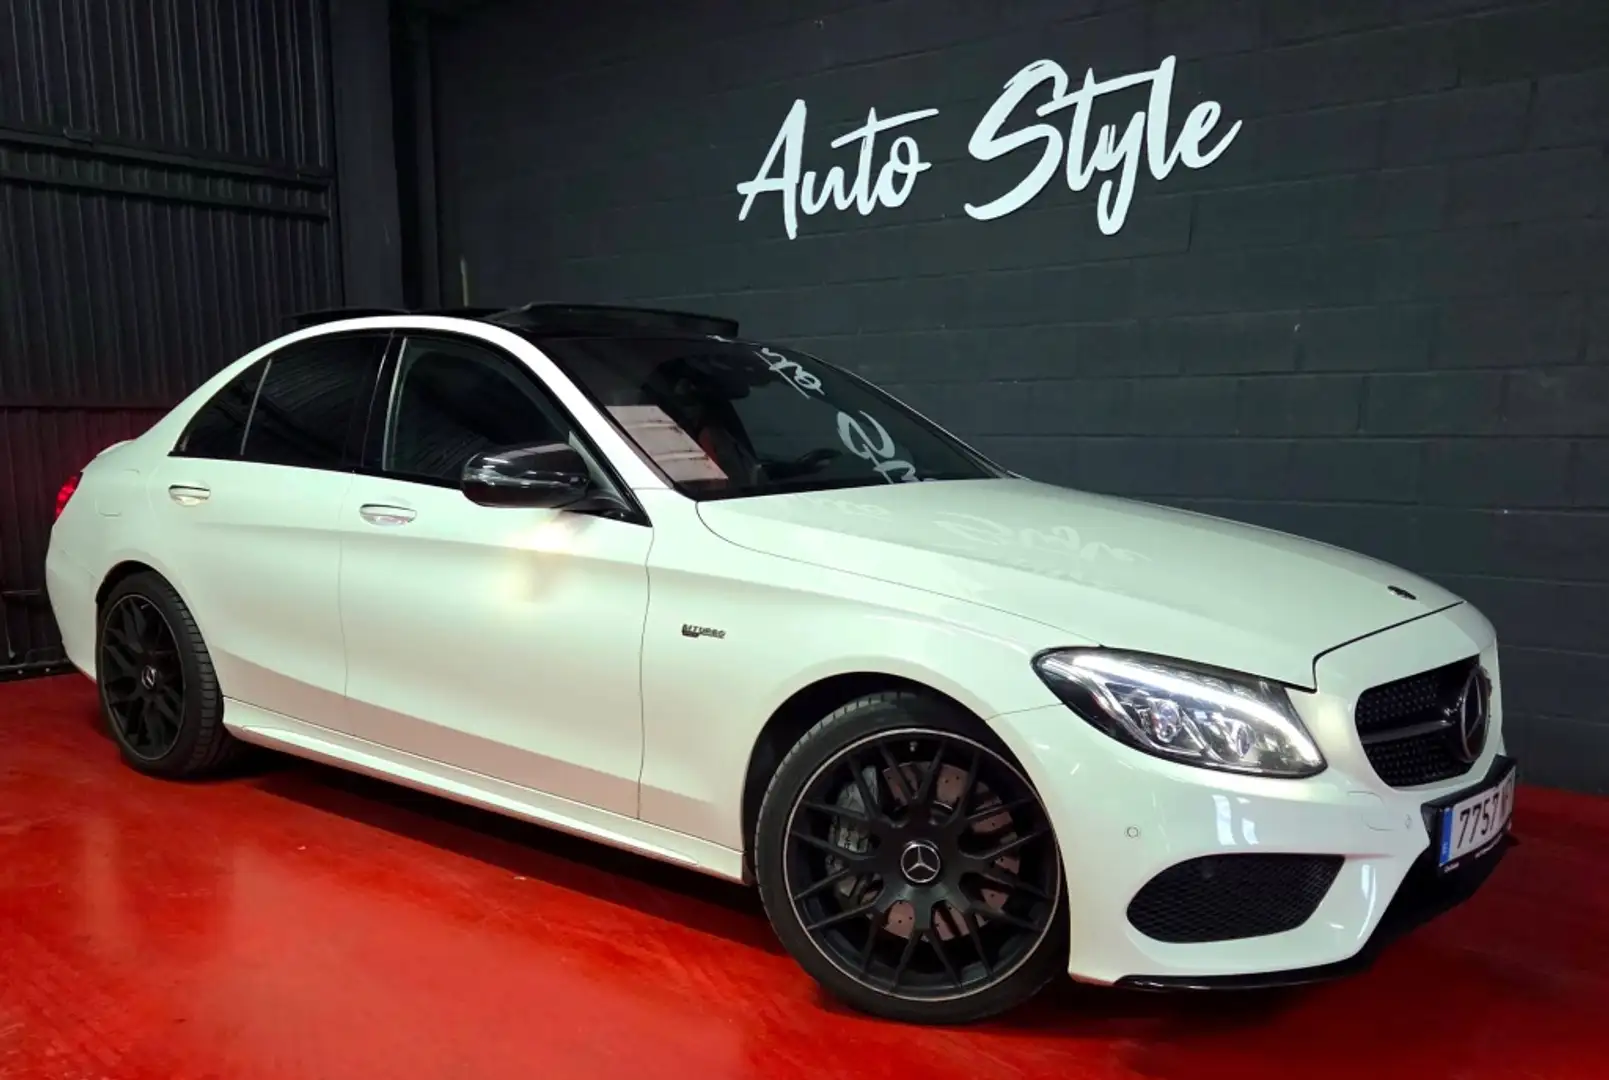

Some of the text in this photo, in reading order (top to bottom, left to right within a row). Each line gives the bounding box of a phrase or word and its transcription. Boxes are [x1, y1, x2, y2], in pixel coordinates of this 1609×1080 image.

[736, 55, 1243, 240] Auto Style
[1457, 792, 1500, 850] 7757
